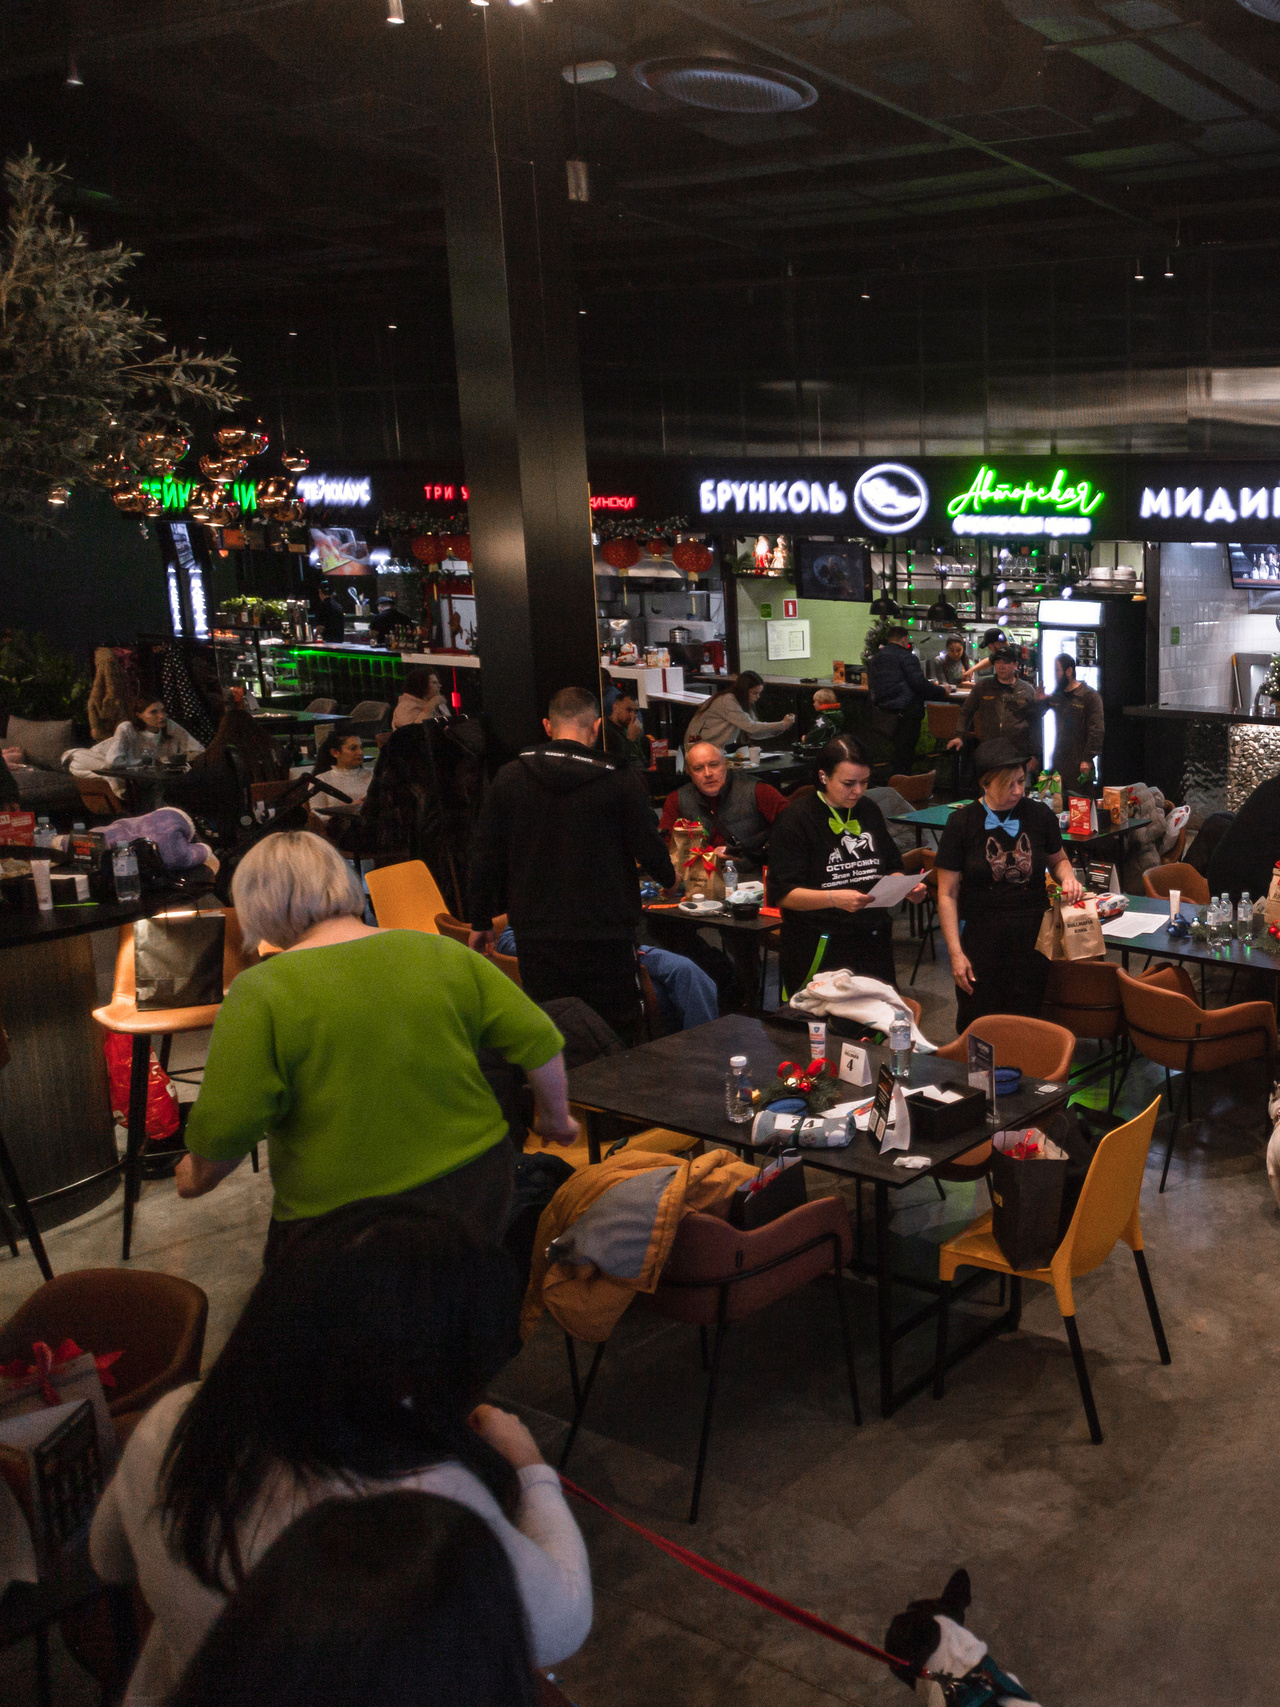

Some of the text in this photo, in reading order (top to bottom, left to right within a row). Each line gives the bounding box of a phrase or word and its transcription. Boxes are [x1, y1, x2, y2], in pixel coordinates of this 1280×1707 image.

[424, 484, 454, 500] ТРИ
[699, 479, 848, 515] БРУНКОЛЬ
[947, 464, 1104, 515] Авторская
[589, 496, 635, 509] КИНСКИ
[846, 1059, 854, 1072] 4
